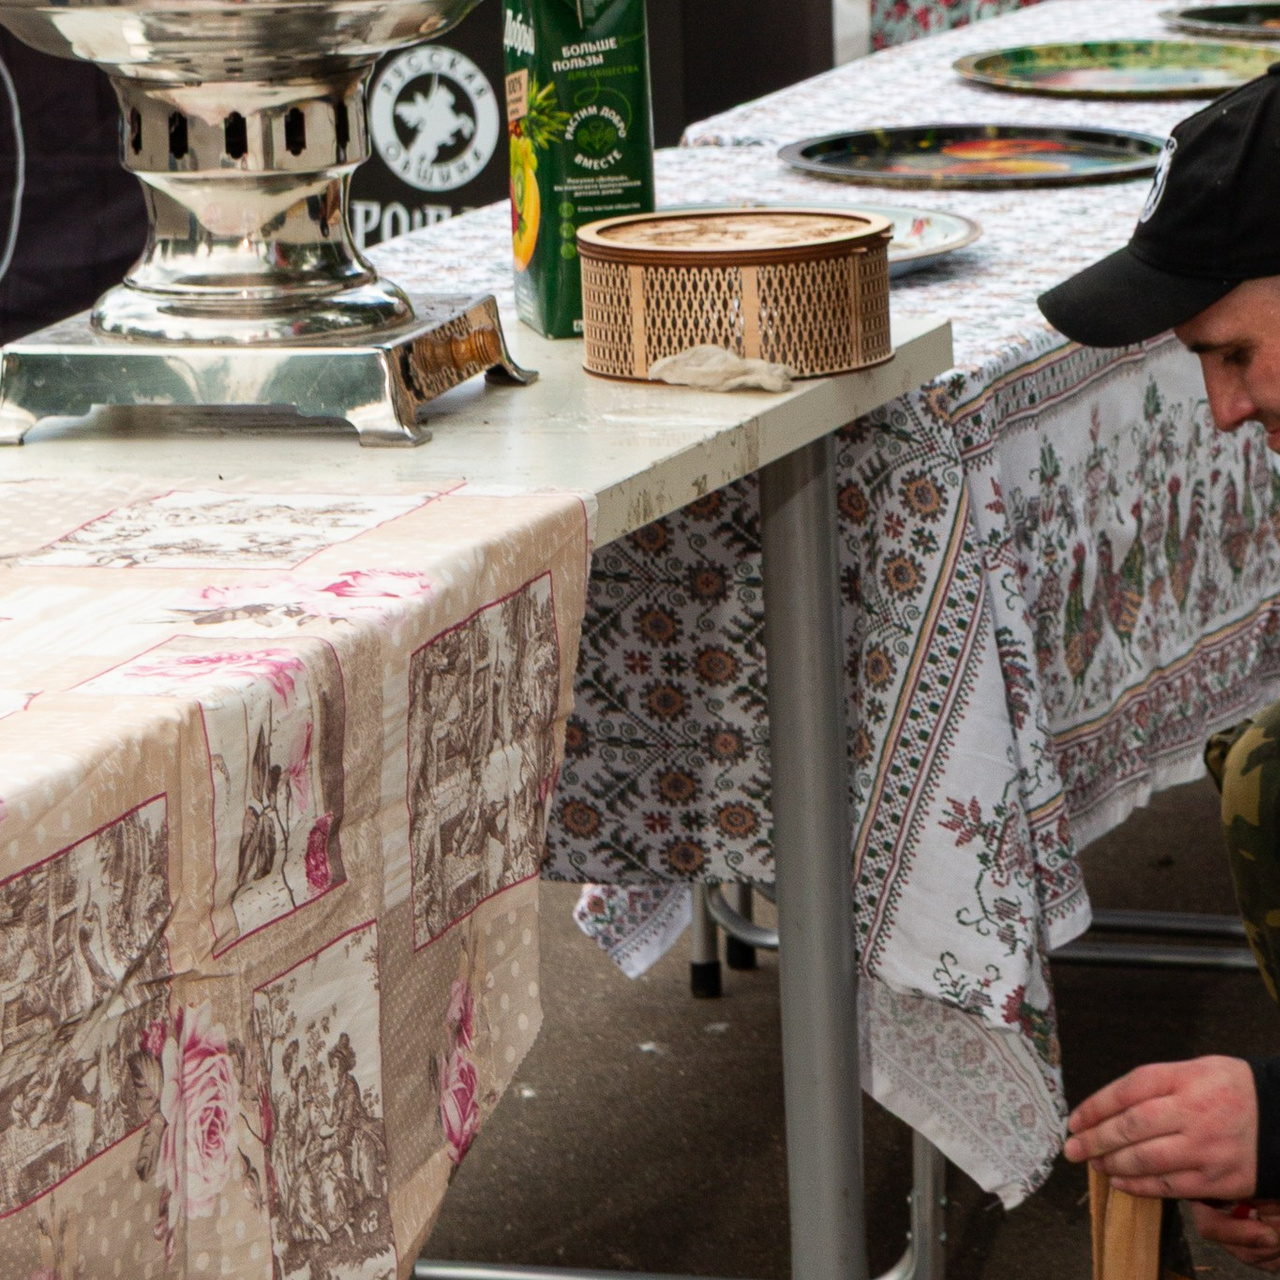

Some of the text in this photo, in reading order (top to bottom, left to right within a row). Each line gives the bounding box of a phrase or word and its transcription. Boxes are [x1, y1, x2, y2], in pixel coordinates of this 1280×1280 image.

[562, 36, 618, 58] БОЛЬШЕ
[552, 53, 604, 72] ПОЛЬЗЫ
[565, 105, 627, 140] РАСТИМ ДОБРО
[574, 148, 622, 170] ВМЕСТЕ
